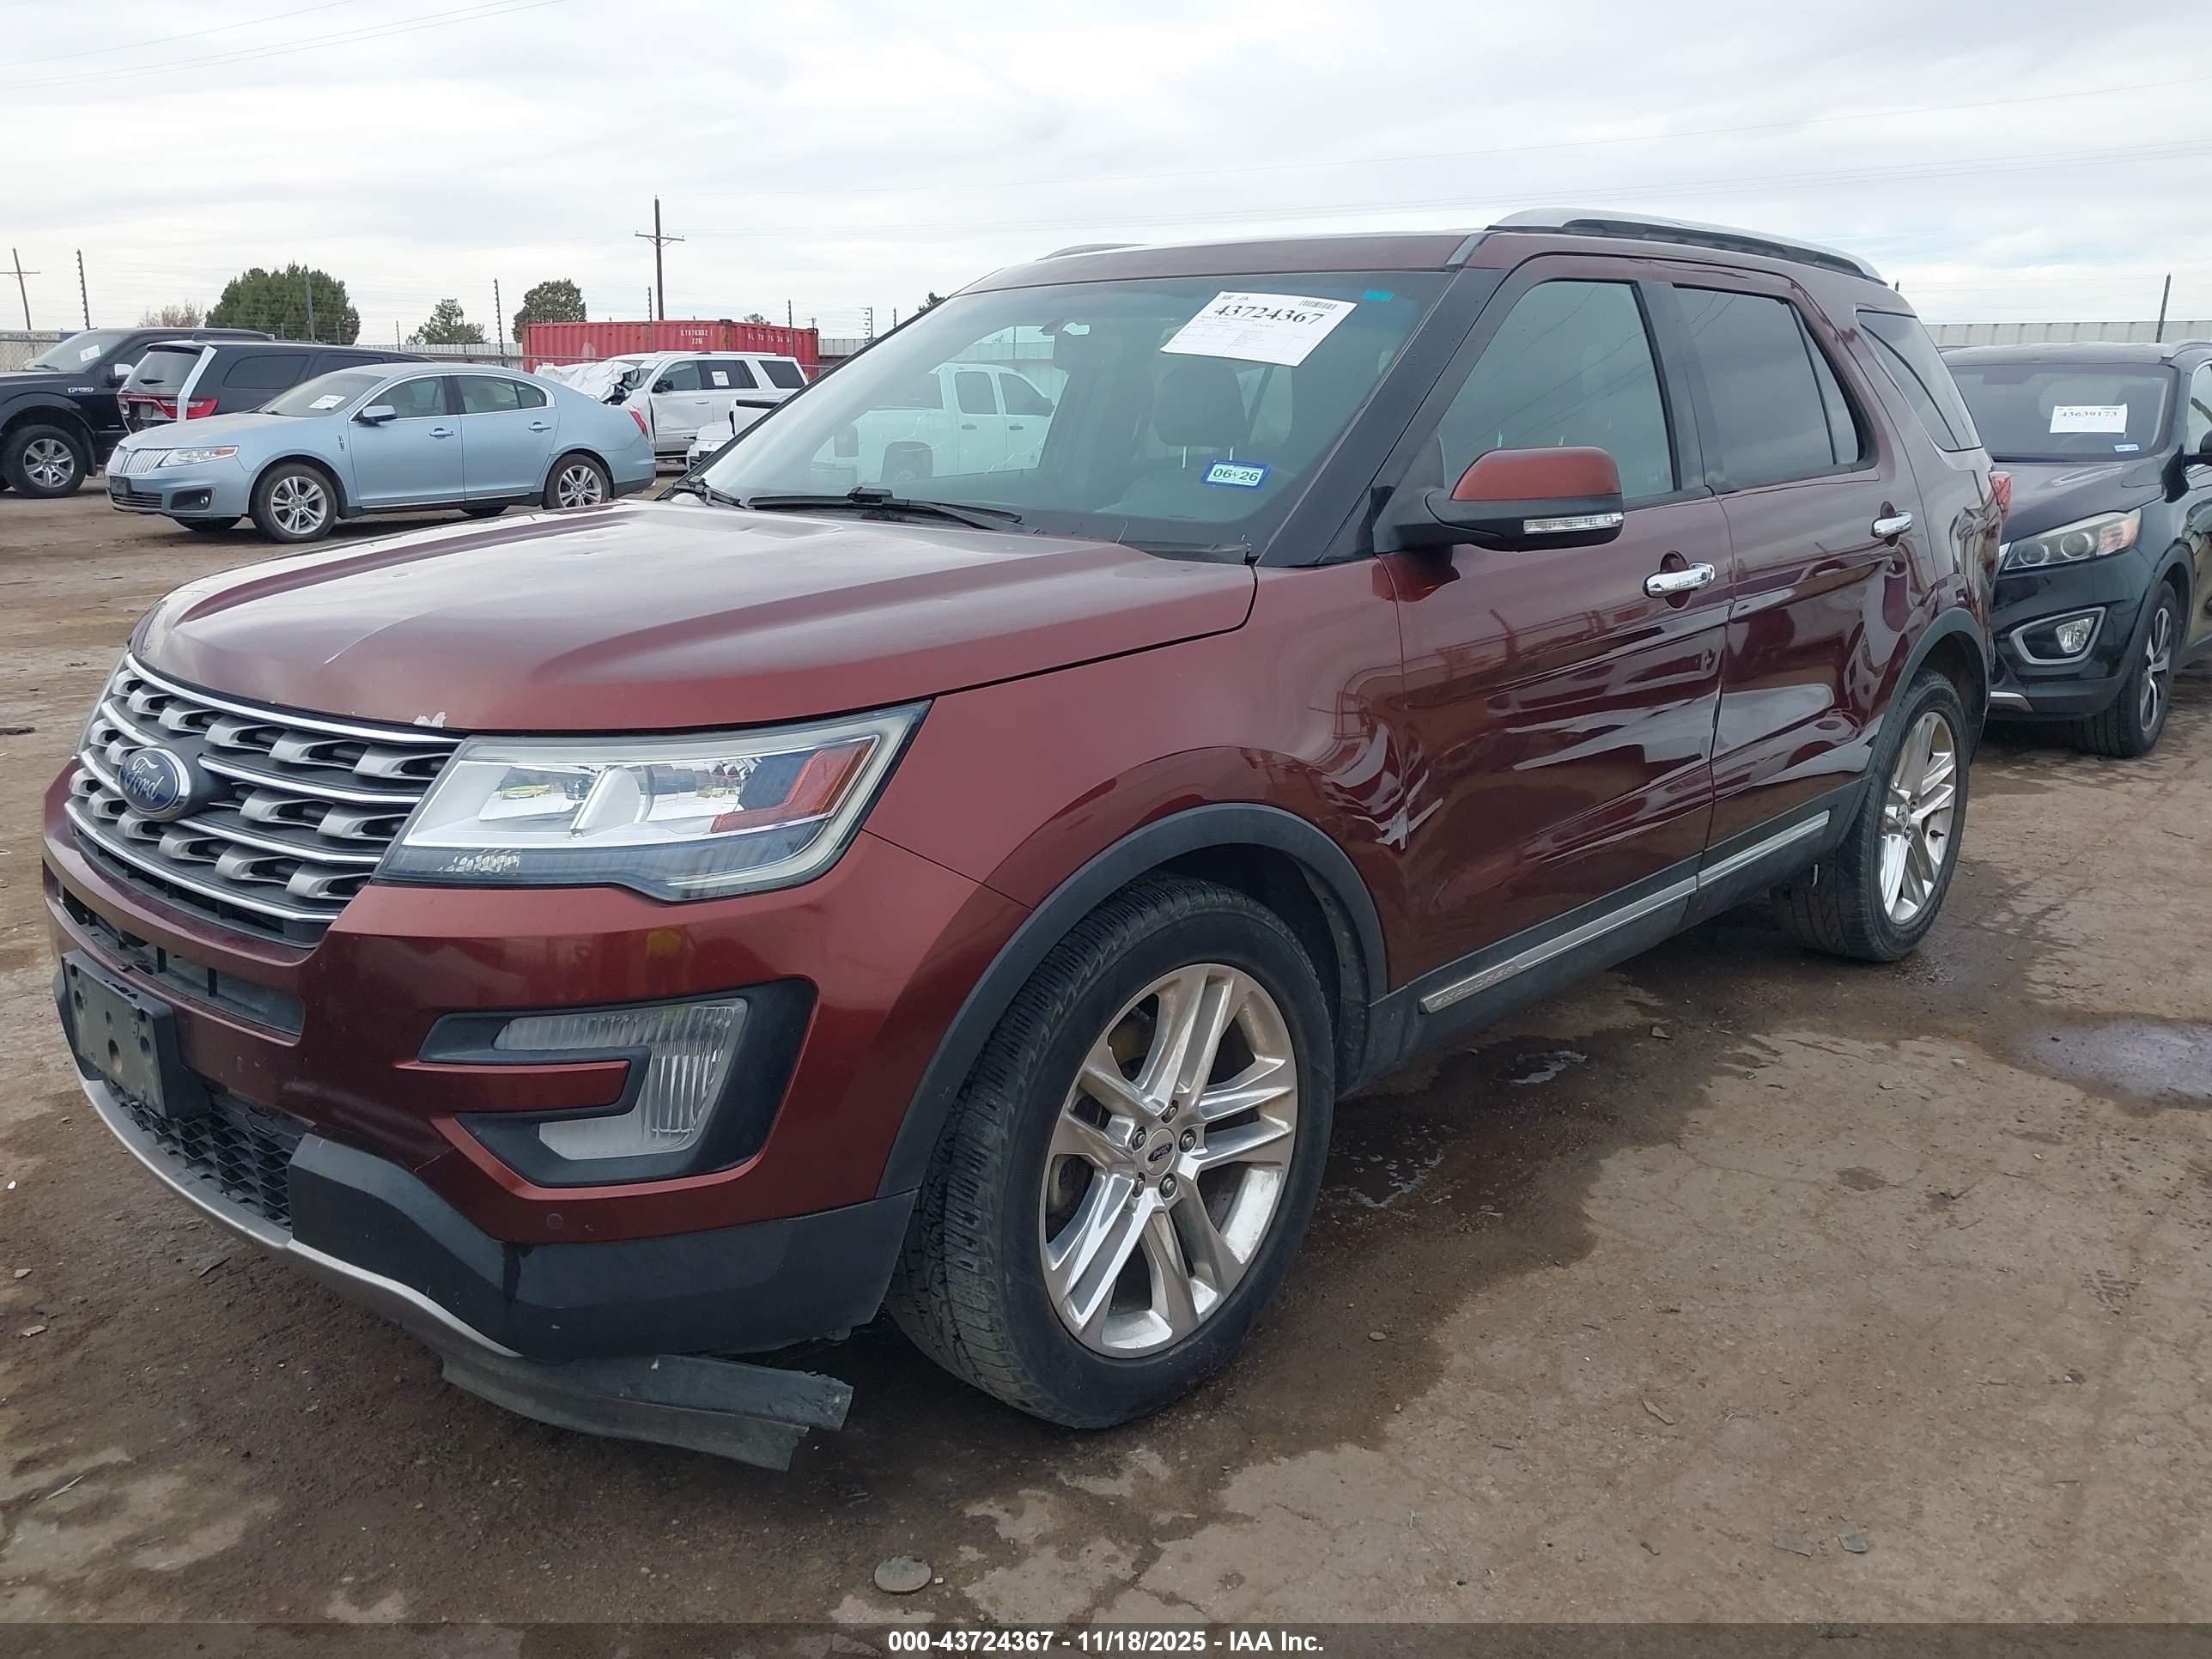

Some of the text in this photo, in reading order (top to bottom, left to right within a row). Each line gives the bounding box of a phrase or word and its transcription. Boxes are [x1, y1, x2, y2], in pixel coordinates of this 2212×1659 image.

[1213, 305, 1325, 325] 43724367
[125, 757, 165, 801] Ford
[1431, 965, 1513, 1008] EXPLORER
